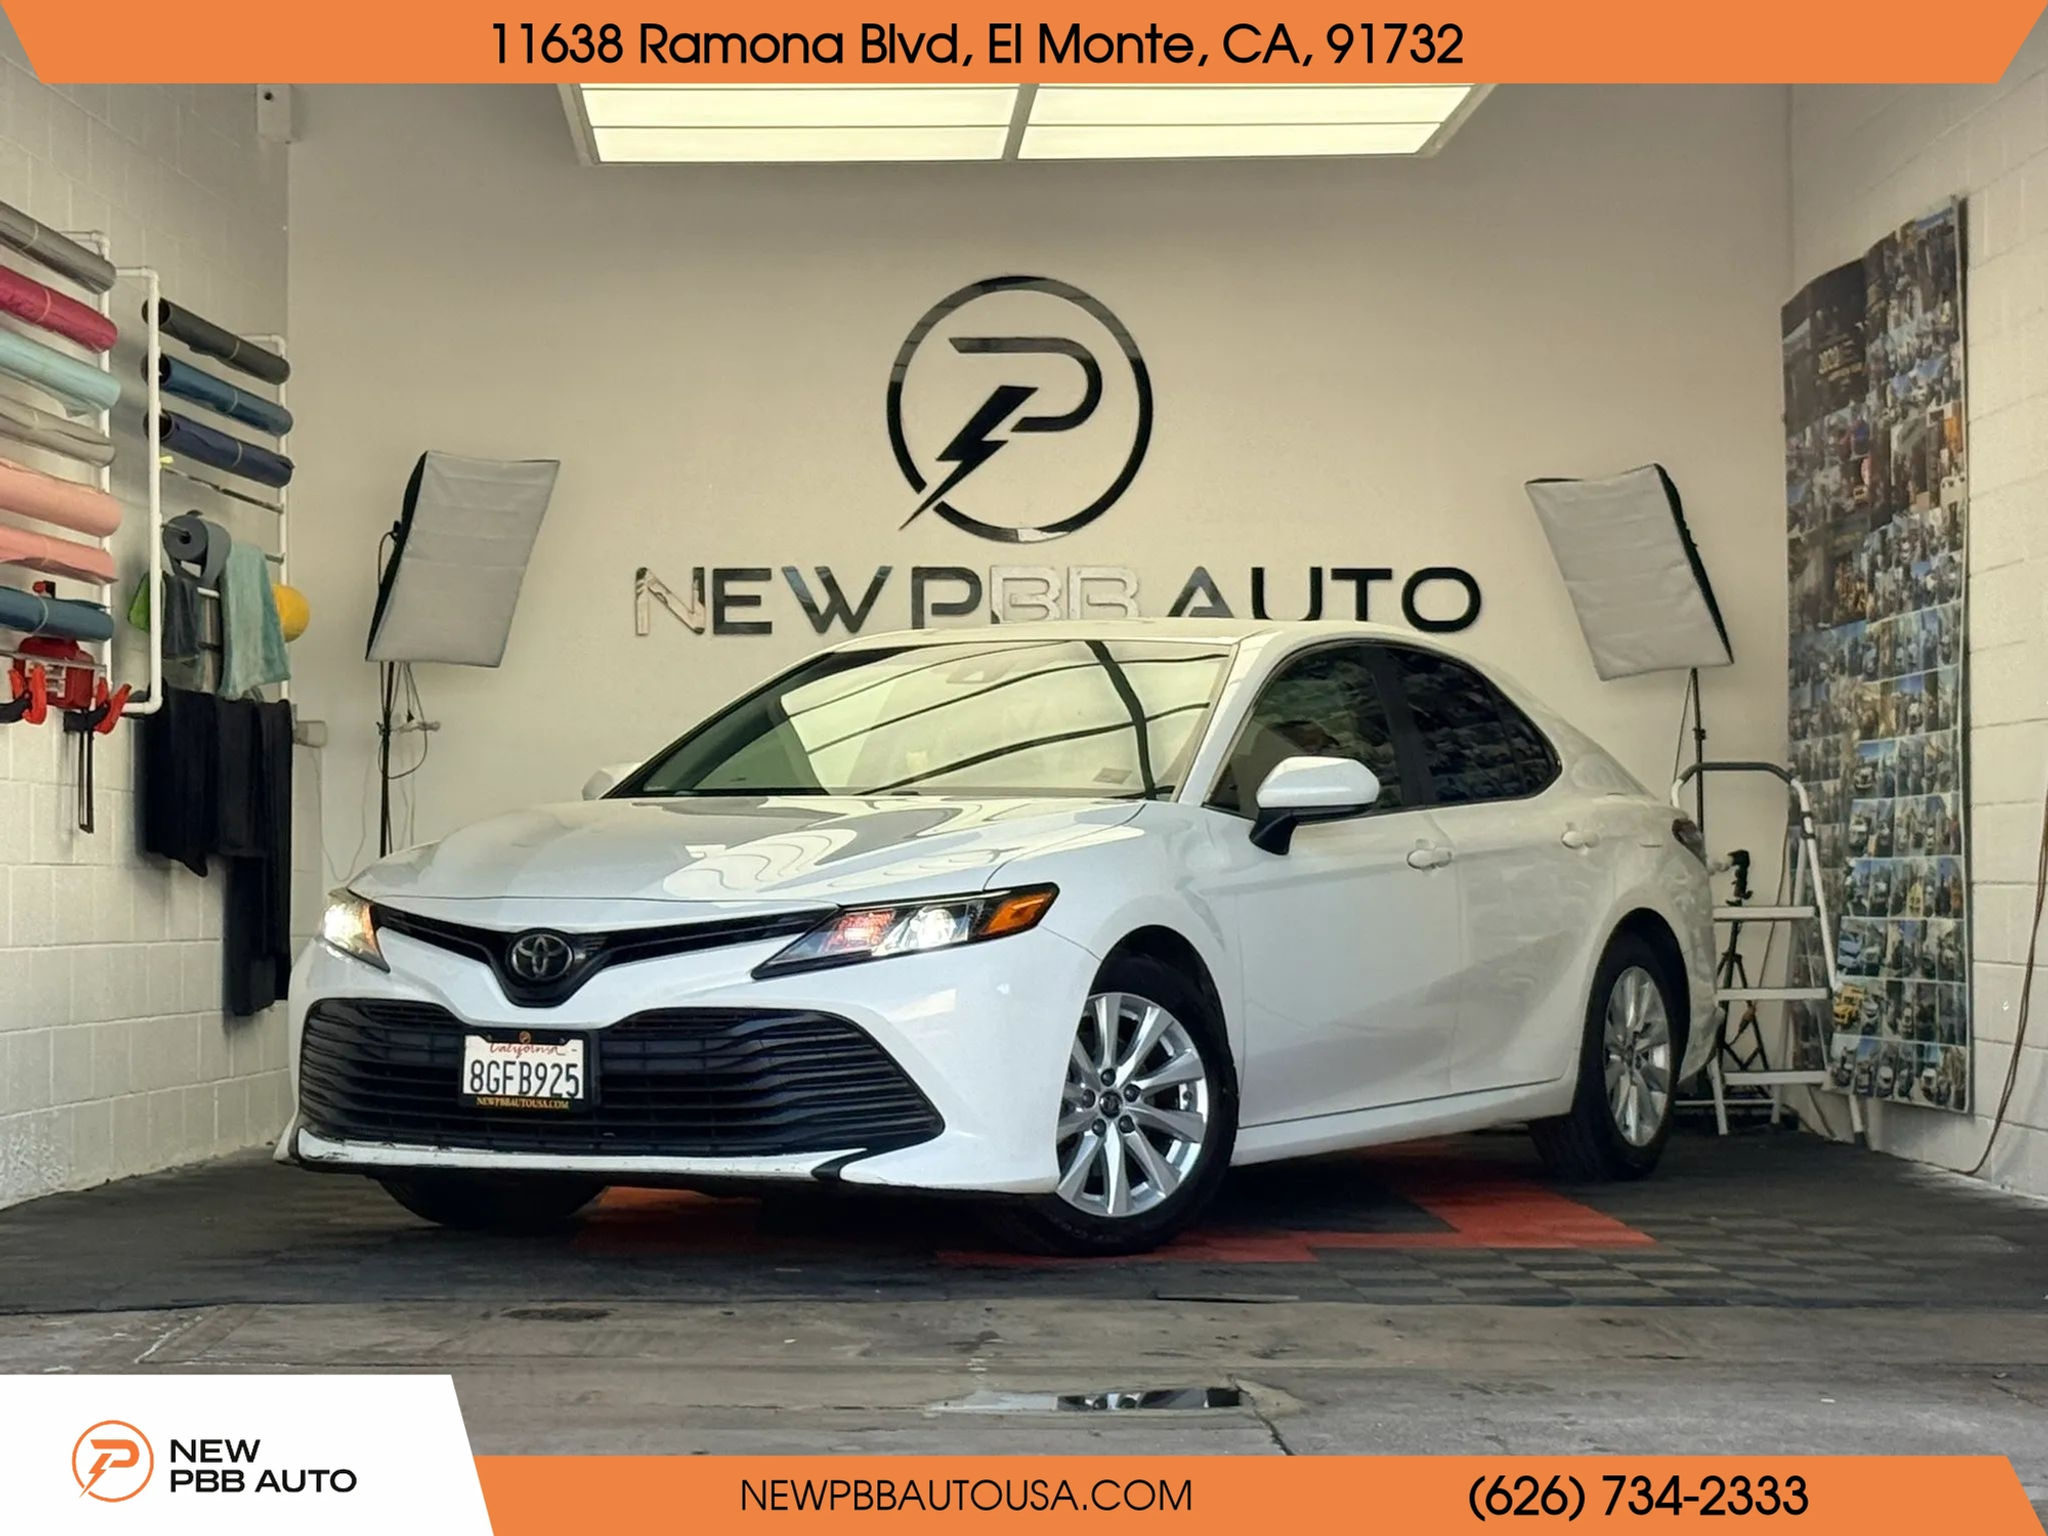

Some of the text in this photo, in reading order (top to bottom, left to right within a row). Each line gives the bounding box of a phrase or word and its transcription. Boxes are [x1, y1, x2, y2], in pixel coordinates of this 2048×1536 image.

[634, 564, 1484, 636] NEW PBB AUTO
[469, 1059, 580, 1099] 8GFB925
